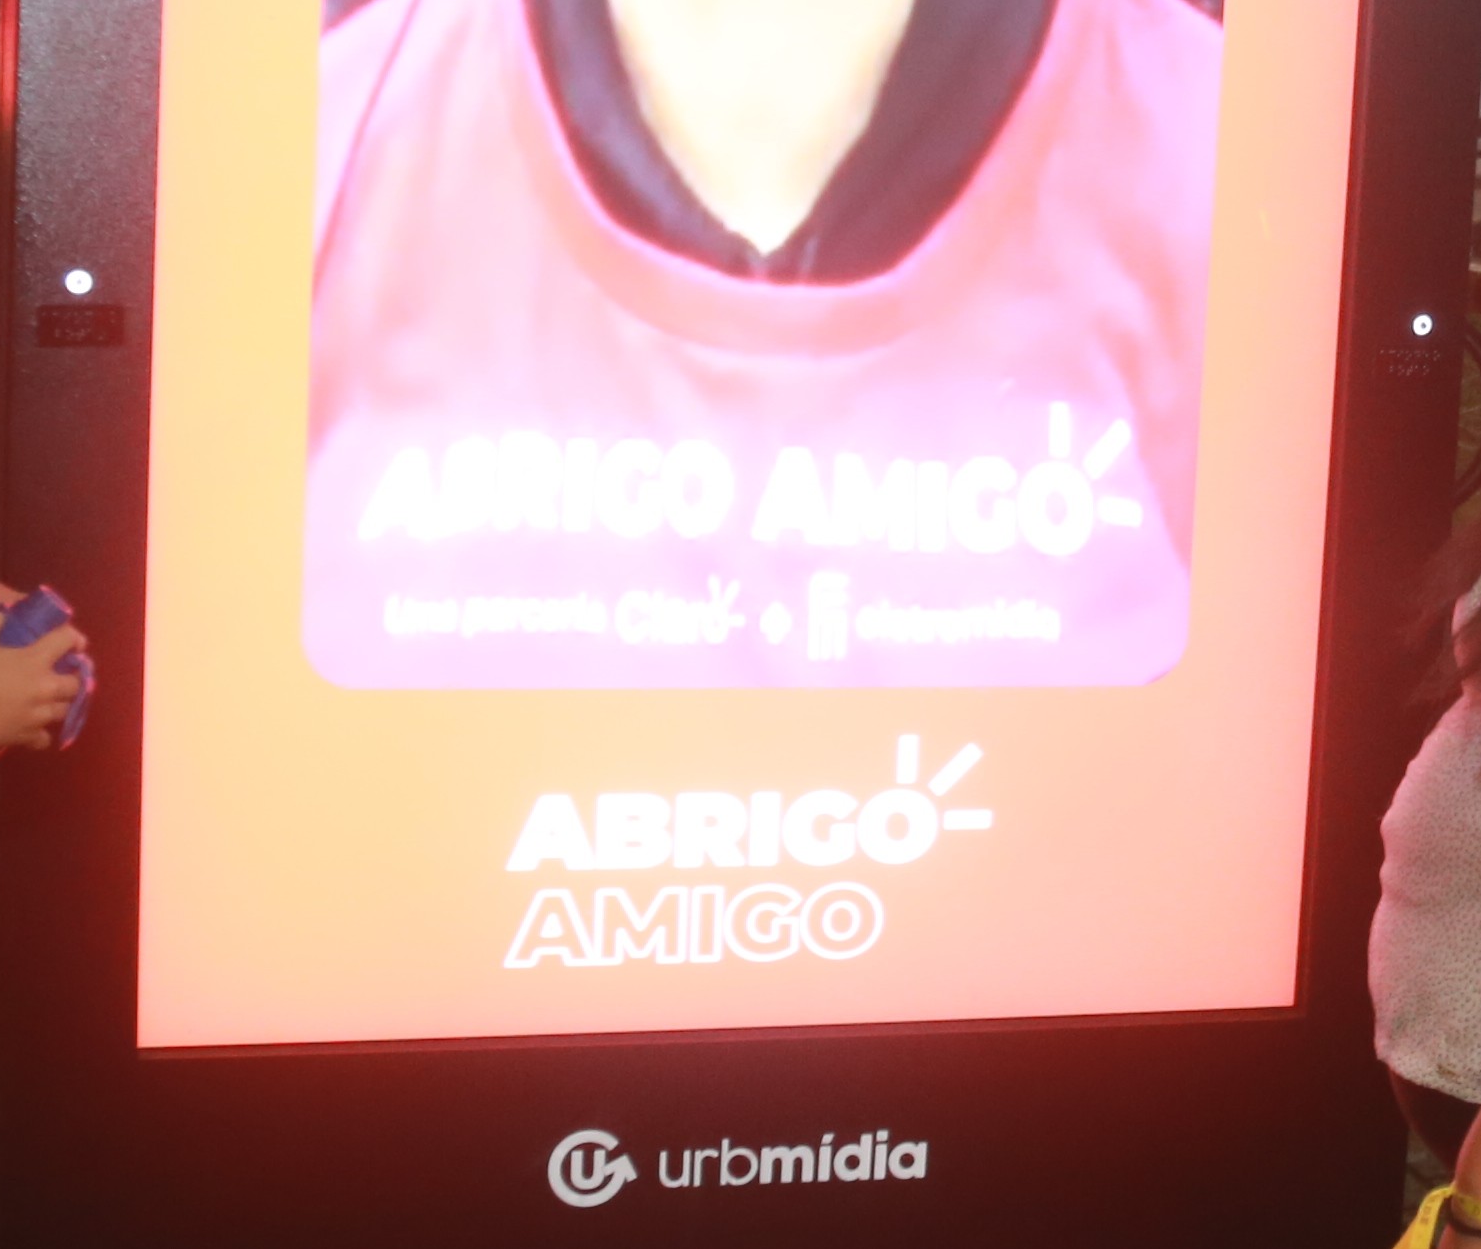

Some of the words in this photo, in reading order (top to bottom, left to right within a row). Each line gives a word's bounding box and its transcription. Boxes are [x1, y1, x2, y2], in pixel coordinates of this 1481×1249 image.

[357, 430, 735, 541] ABRIGO
[750, 447, 1096, 556] AMIGO
[505, 788, 939, 872] ABRIGO
[502, 880, 885, 969] AMIGO
[658, 1129, 928, 1189] urbmídia
